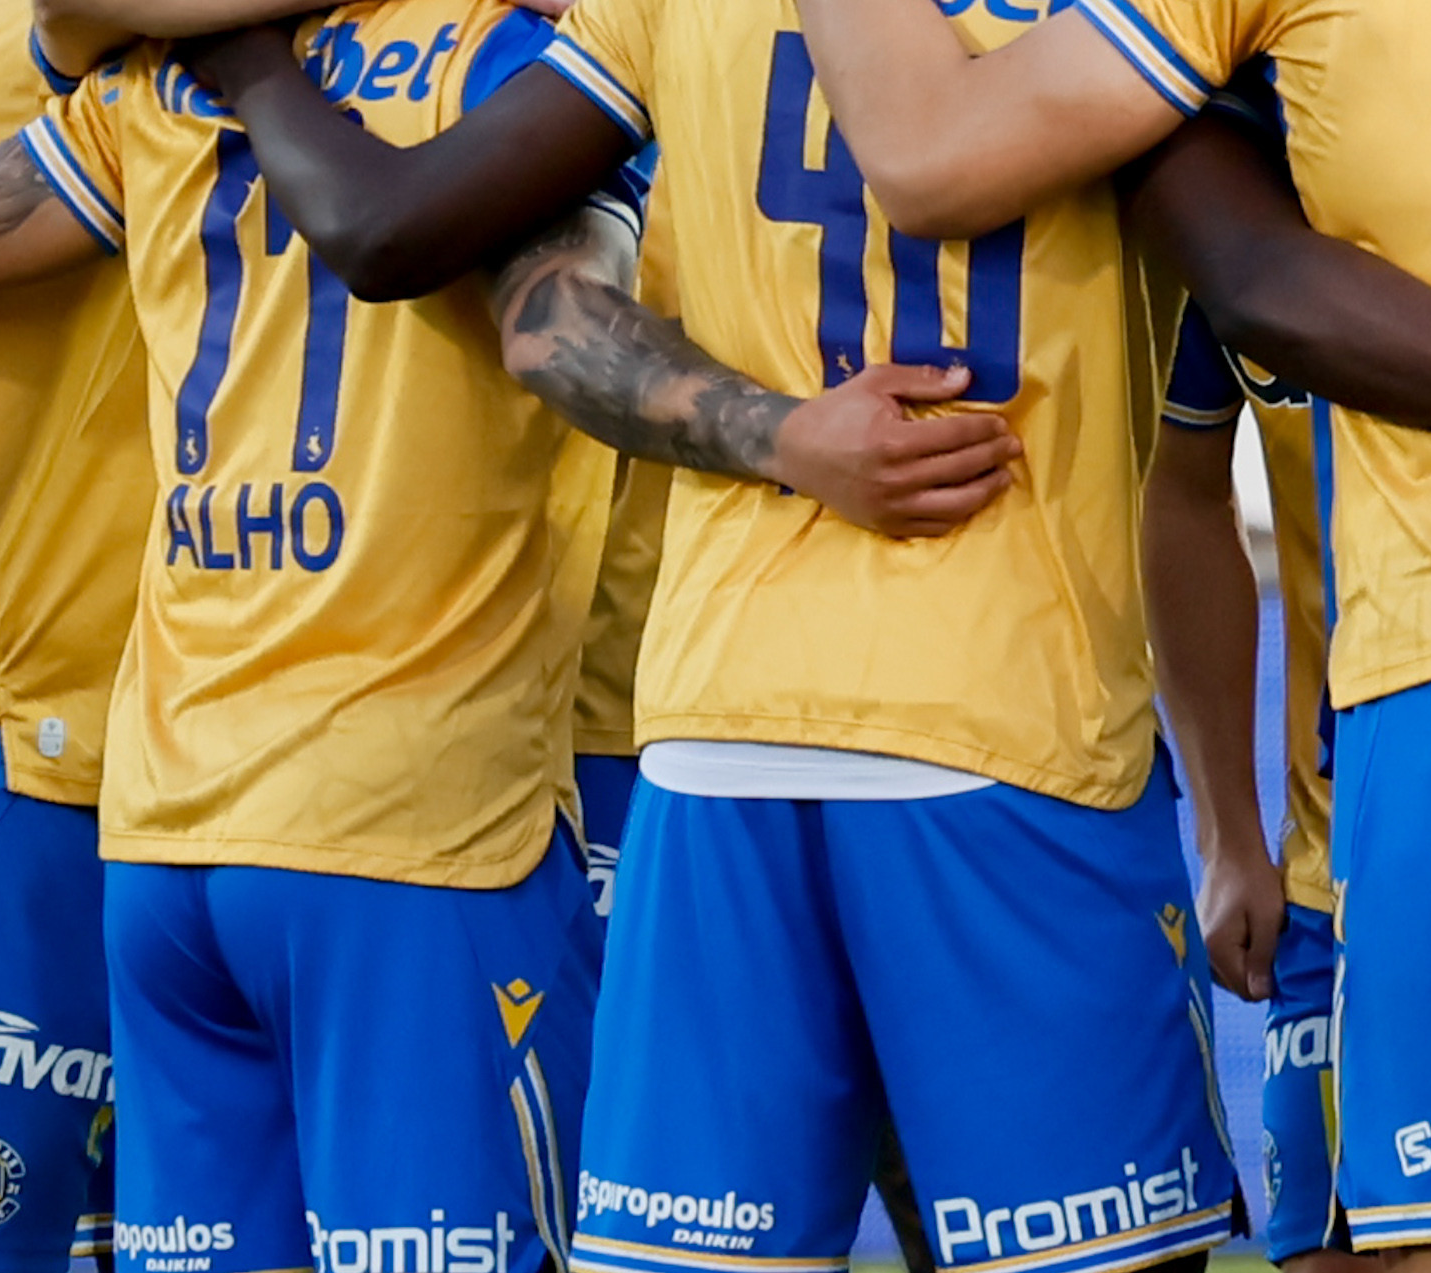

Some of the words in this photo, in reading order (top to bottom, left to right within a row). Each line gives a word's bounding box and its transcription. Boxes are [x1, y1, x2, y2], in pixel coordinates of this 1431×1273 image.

[167, 481, 345, 573] ALHO
[933, 1147, 1201, 1264] Promist
[145, 1257, 211, 1272] DAIKIN
[671, 1228, 755, 1251] DAIKIN
